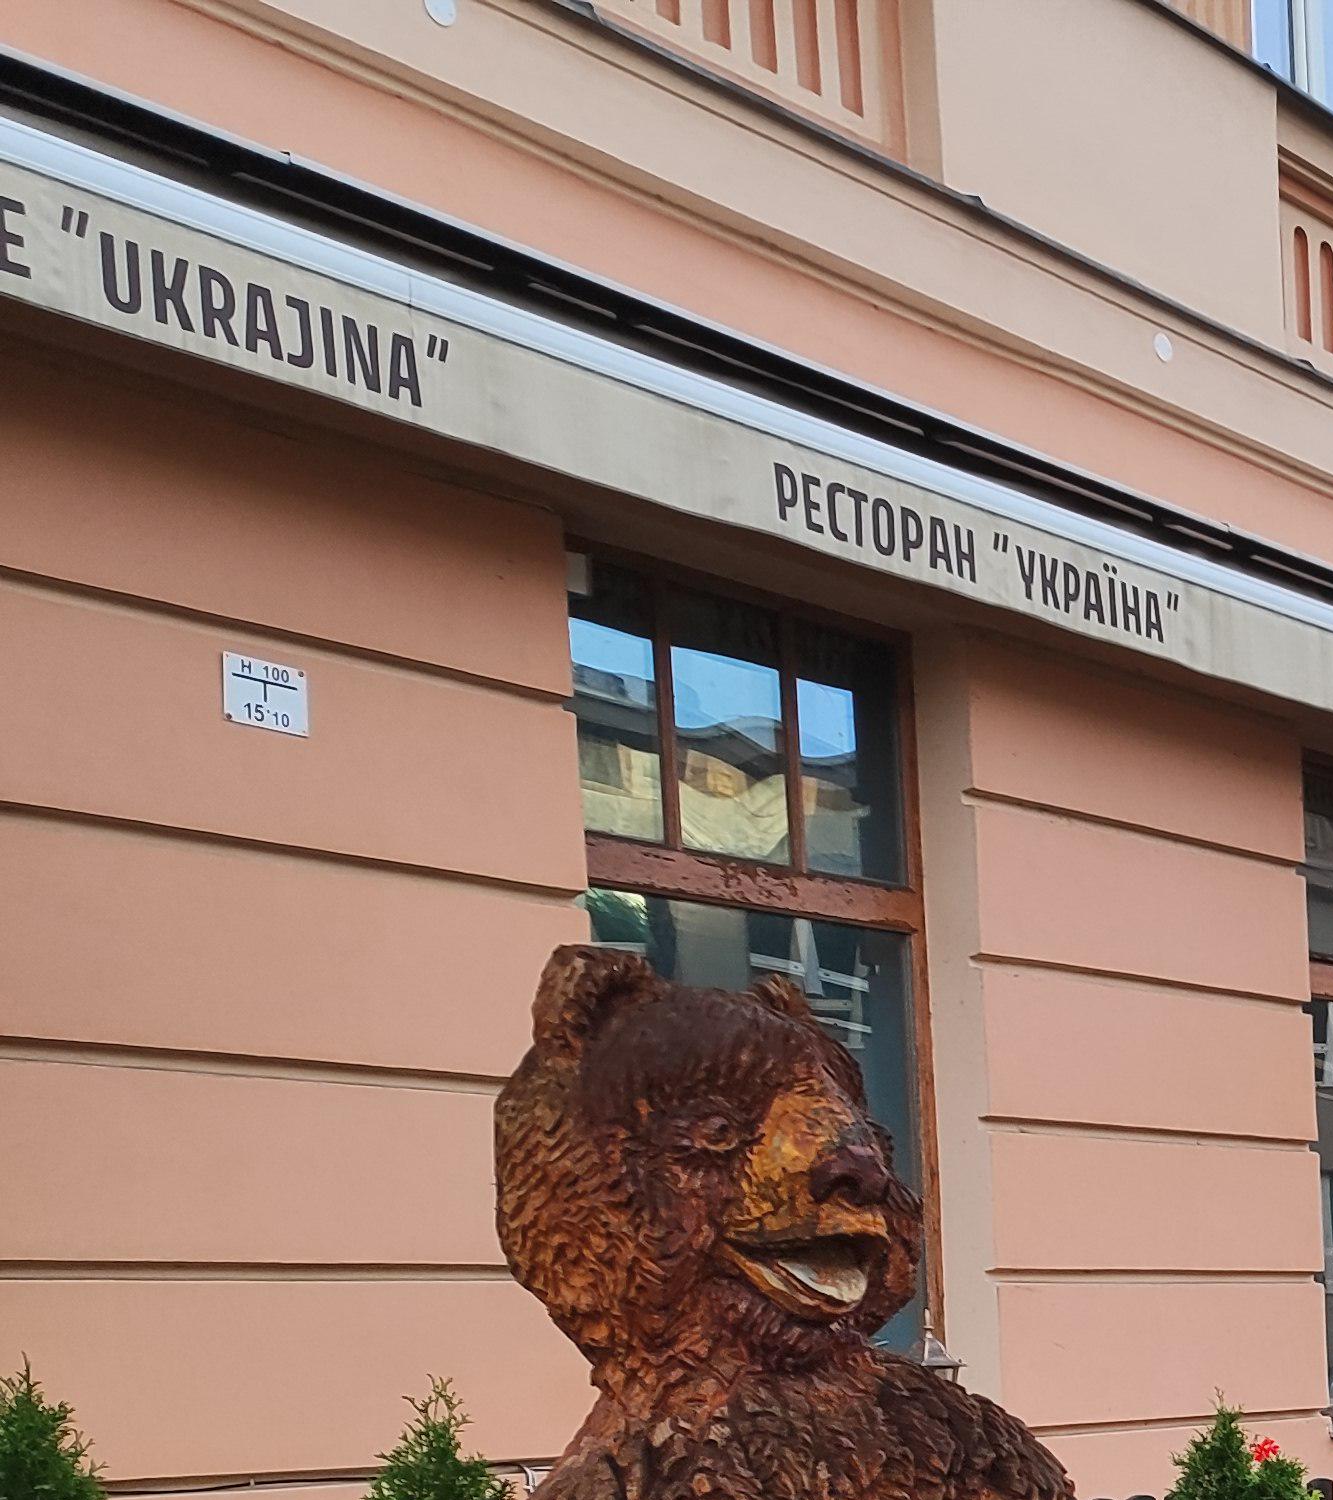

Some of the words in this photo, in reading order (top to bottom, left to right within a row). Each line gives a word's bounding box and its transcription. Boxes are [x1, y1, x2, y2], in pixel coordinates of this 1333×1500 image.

[61, 205, 448, 407] "UKRAJINA"
[774, 462, 976, 583] РЕСТОРАН
[993, 531, 1179, 643] "УКРАЇНА"
[241, 659, 251, 674] H
[262, 665, 289, 683] 100
